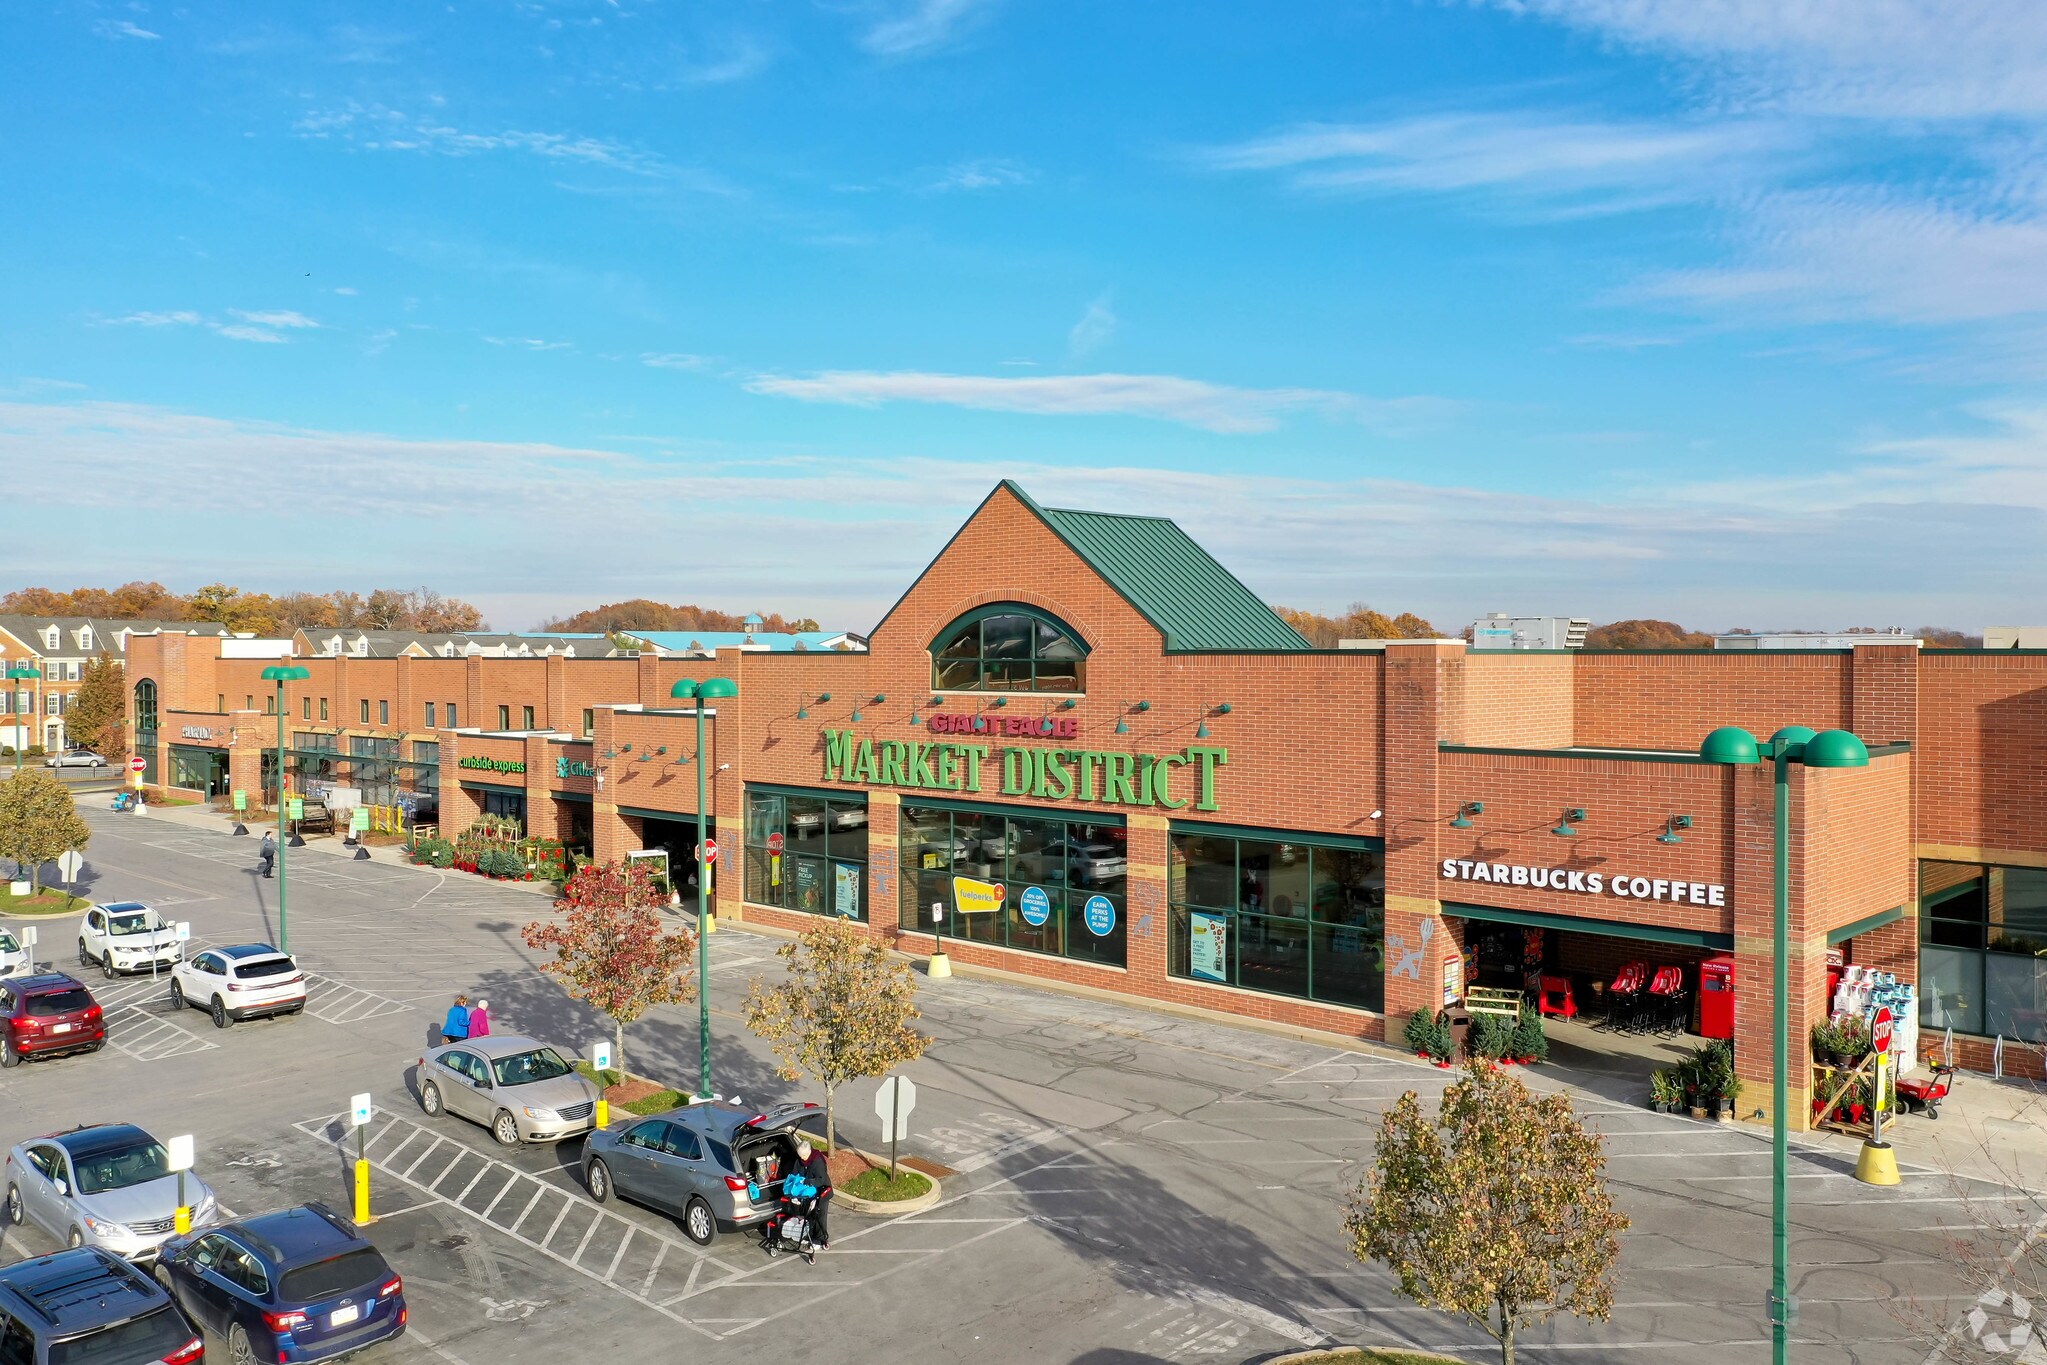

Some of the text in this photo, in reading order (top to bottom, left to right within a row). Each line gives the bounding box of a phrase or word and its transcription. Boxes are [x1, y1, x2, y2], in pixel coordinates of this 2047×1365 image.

[460, 757, 525, 775] curbside express
[823, 728, 1228, 811] MARKET DISTRICT
[1442, 859, 1725, 907] STARBUCKS COFFEE
[960, 888, 993, 902] fuelperks
[1091, 908, 1108, 916] PERKS
[1092, 901, 1107, 909] EARN
[1874, 1020, 1891, 1040] STOP
